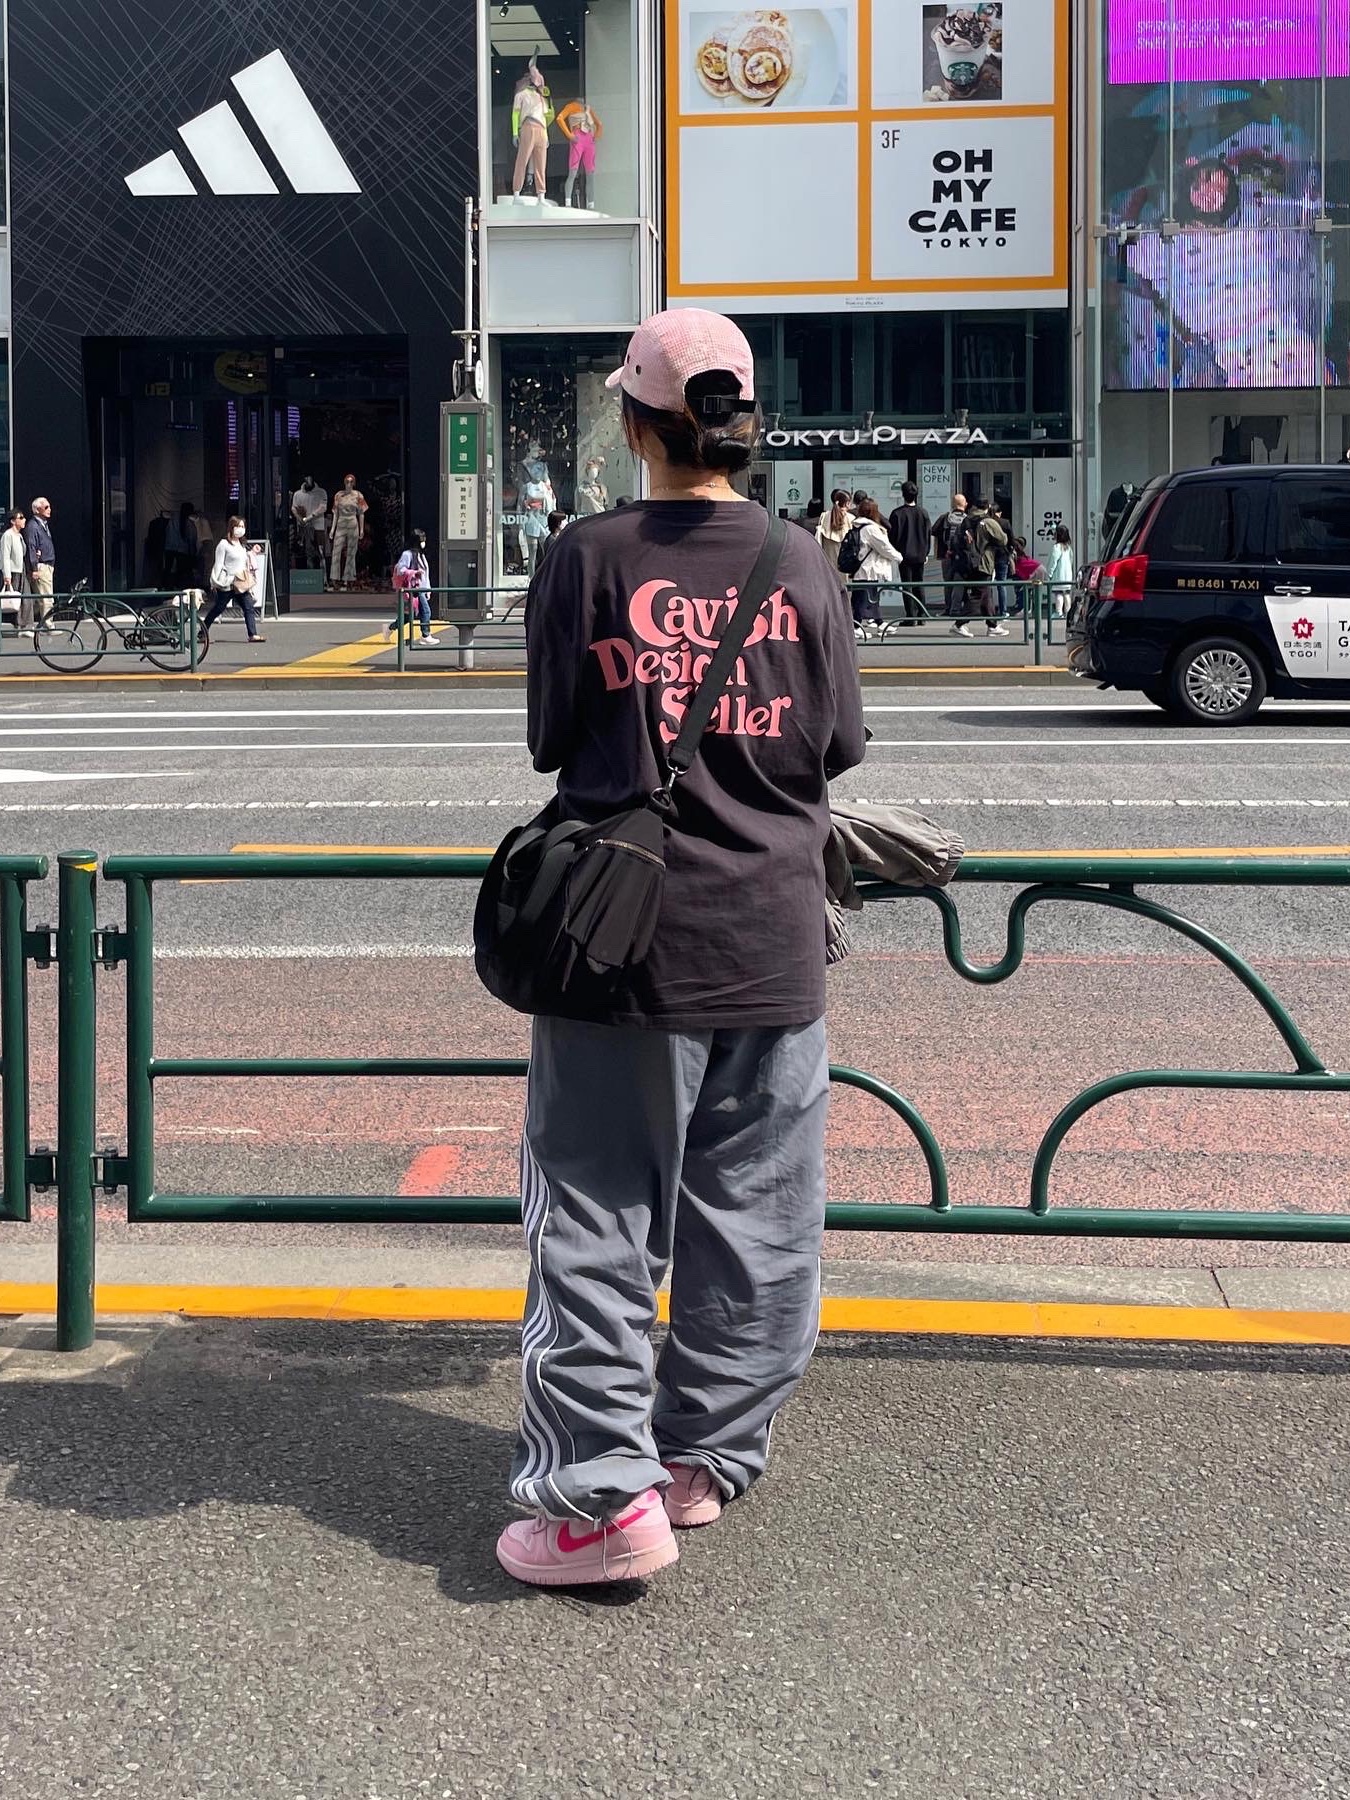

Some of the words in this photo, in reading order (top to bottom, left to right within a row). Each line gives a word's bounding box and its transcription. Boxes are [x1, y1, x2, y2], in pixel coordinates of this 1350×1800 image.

[881, 130, 900, 149] 3F
[932, 148, 993, 174] OH
[932, 179, 993, 204] MY
[908, 207, 1018, 234] CAFE
[922, 237, 1007, 249] TOKYO
[760, 428, 861, 446] OKYU
[872, 425, 989, 445] PLAZA
[923, 465, 947, 474] NEW
[923, 474, 950, 484] OPEN
[1043, 511, 1062, 519] OH
[1036, 529, 1054, 537] CA
[1230, 579, 1260, 590] TAXI
[1283, 641, 1322, 649] 日本交通
[659, 685, 793, 744] Sller
